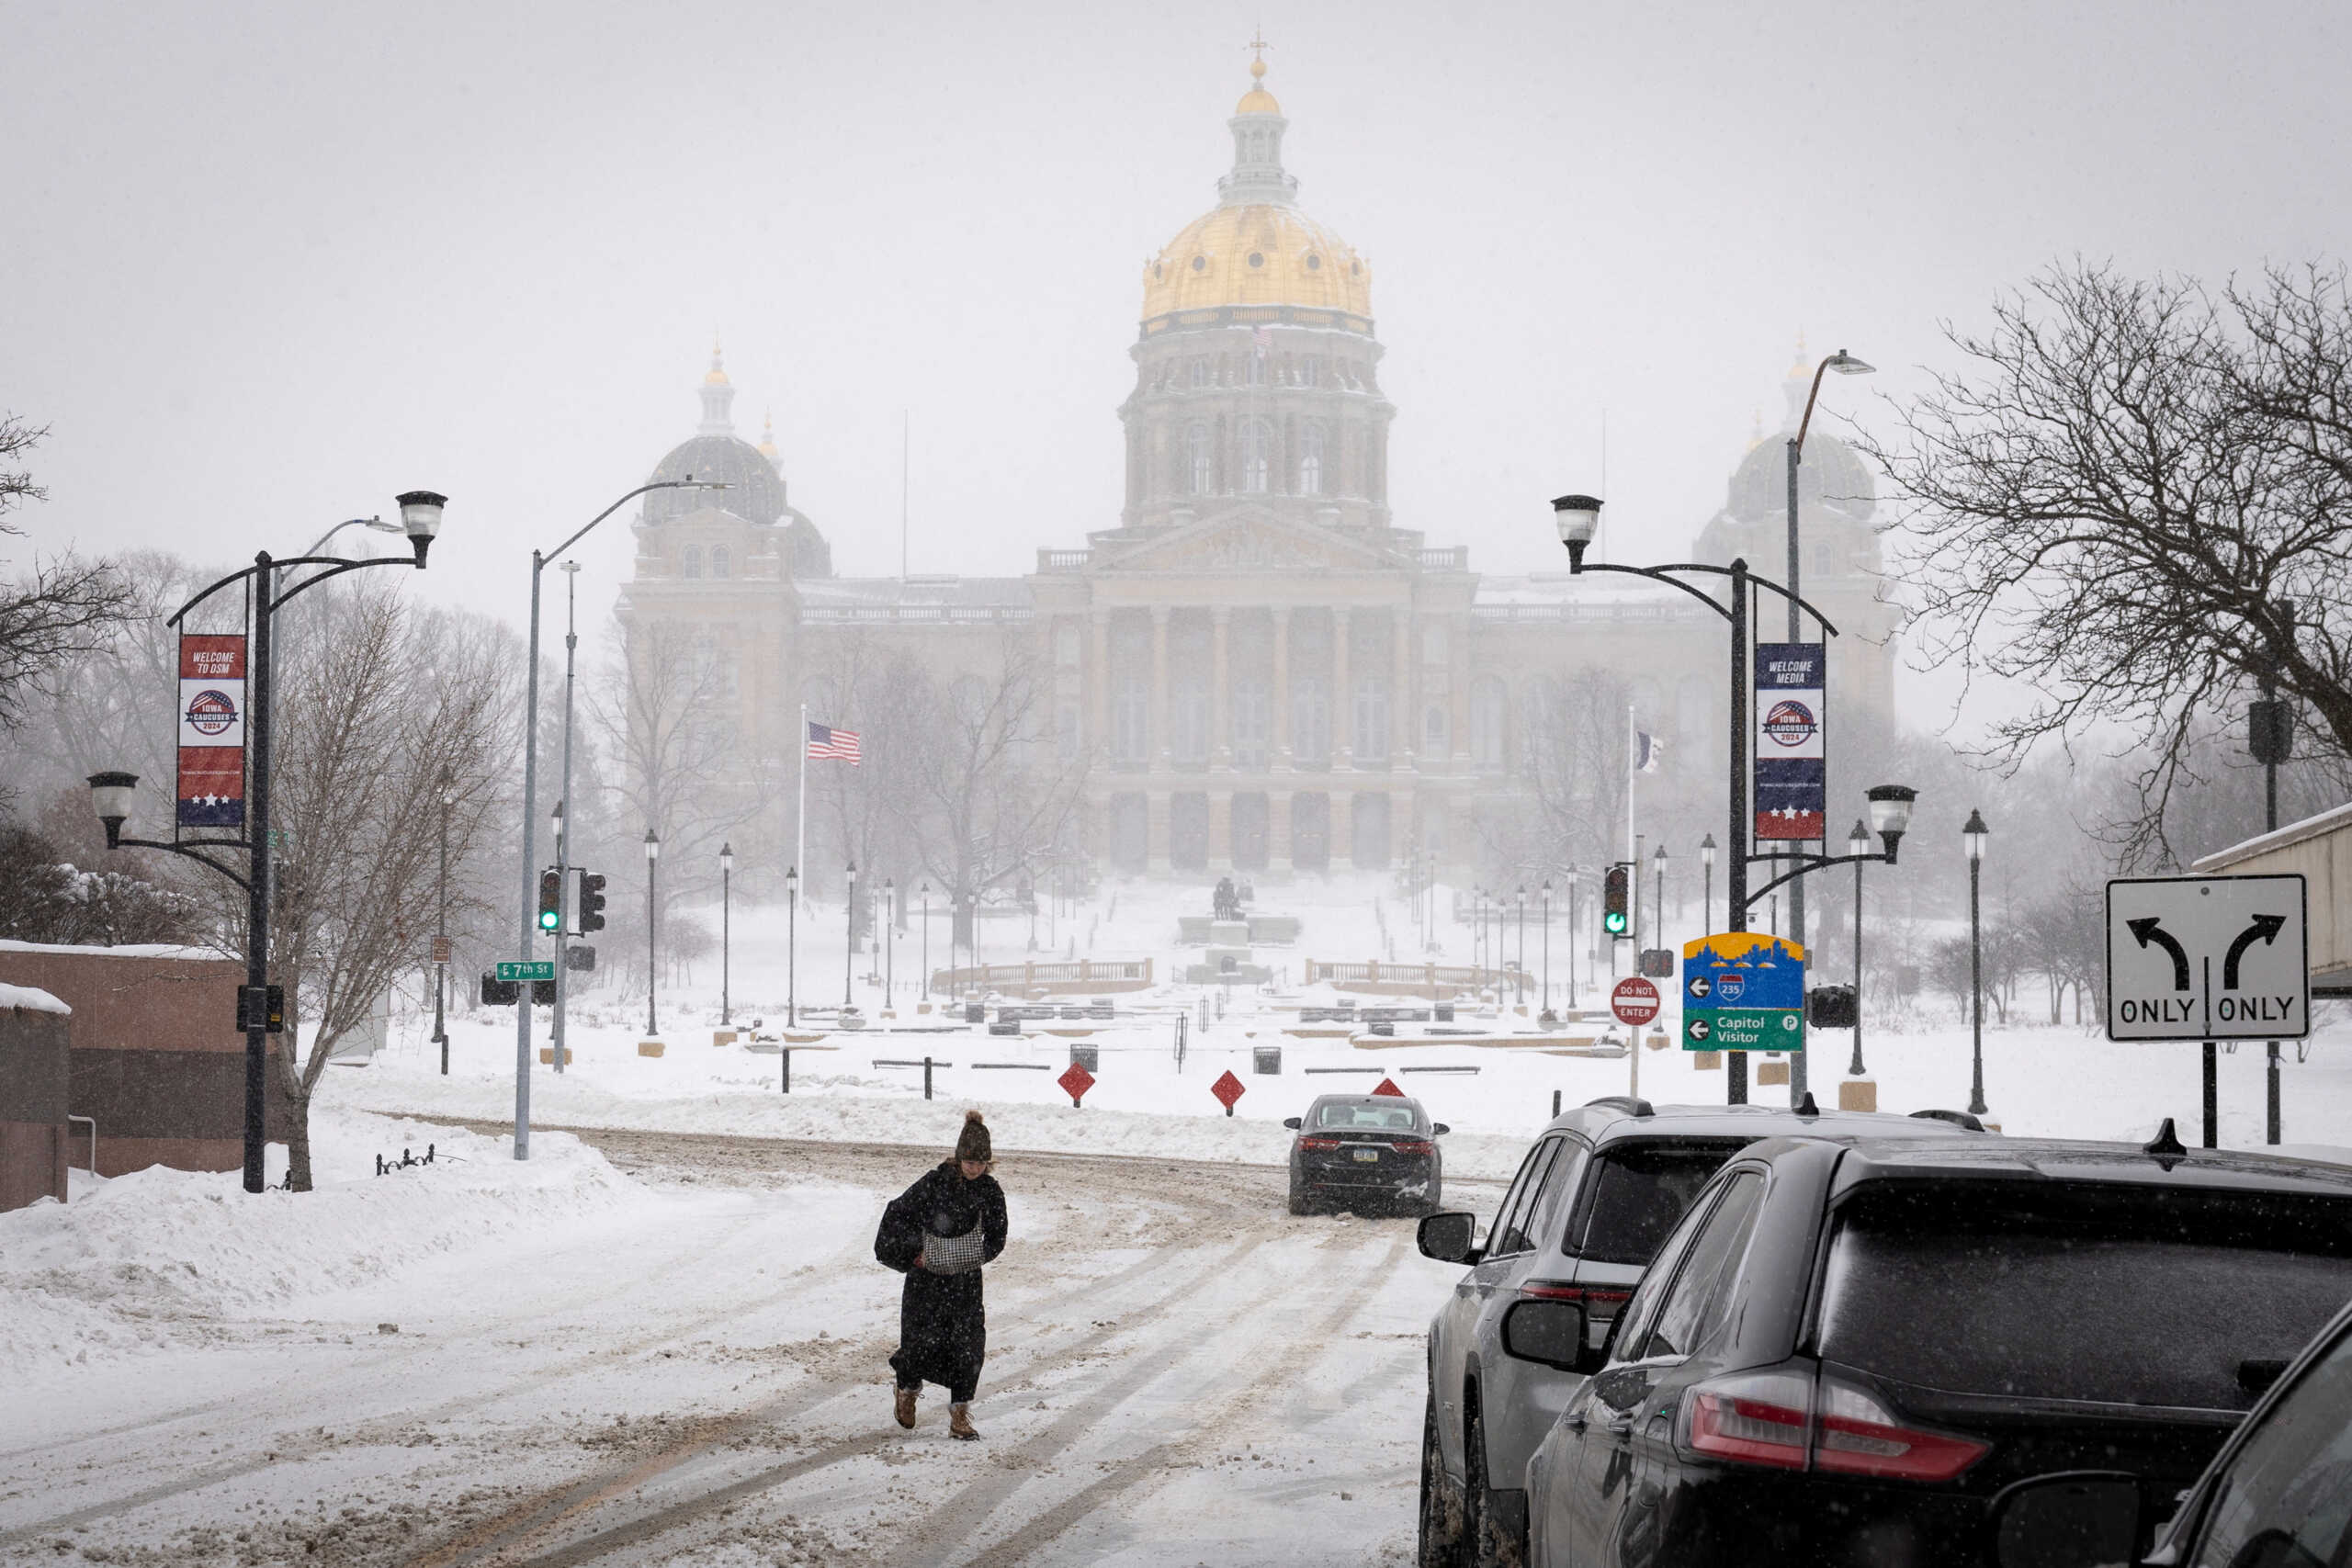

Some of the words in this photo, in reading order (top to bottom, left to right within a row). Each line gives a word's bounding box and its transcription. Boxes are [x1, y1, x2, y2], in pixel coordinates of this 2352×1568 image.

[193, 652, 235, 662] WELCOME
[198, 663, 209, 673] TO
[210, 663, 230, 674] DSM
[1769, 661, 1814, 671] WELCOME
[1776, 673, 1805, 683] MEDIA
[1780, 716, 1802, 724] IOWA
[513, 964, 533, 977] 7th
[537, 964, 548, 974] St
[1621, 987, 1633, 995] DO
[1636, 987, 1653, 995] NOT
[1722, 985, 1740, 994] 235
[1621, 1008, 1650, 1017] ENTER
[2120, 998, 2196, 1023] ONLY
[2218, 997, 2294, 1021] ONLY
[1717, 1017, 1765, 1030] Capitol
[1717, 1032, 1758, 1043] Visitor
